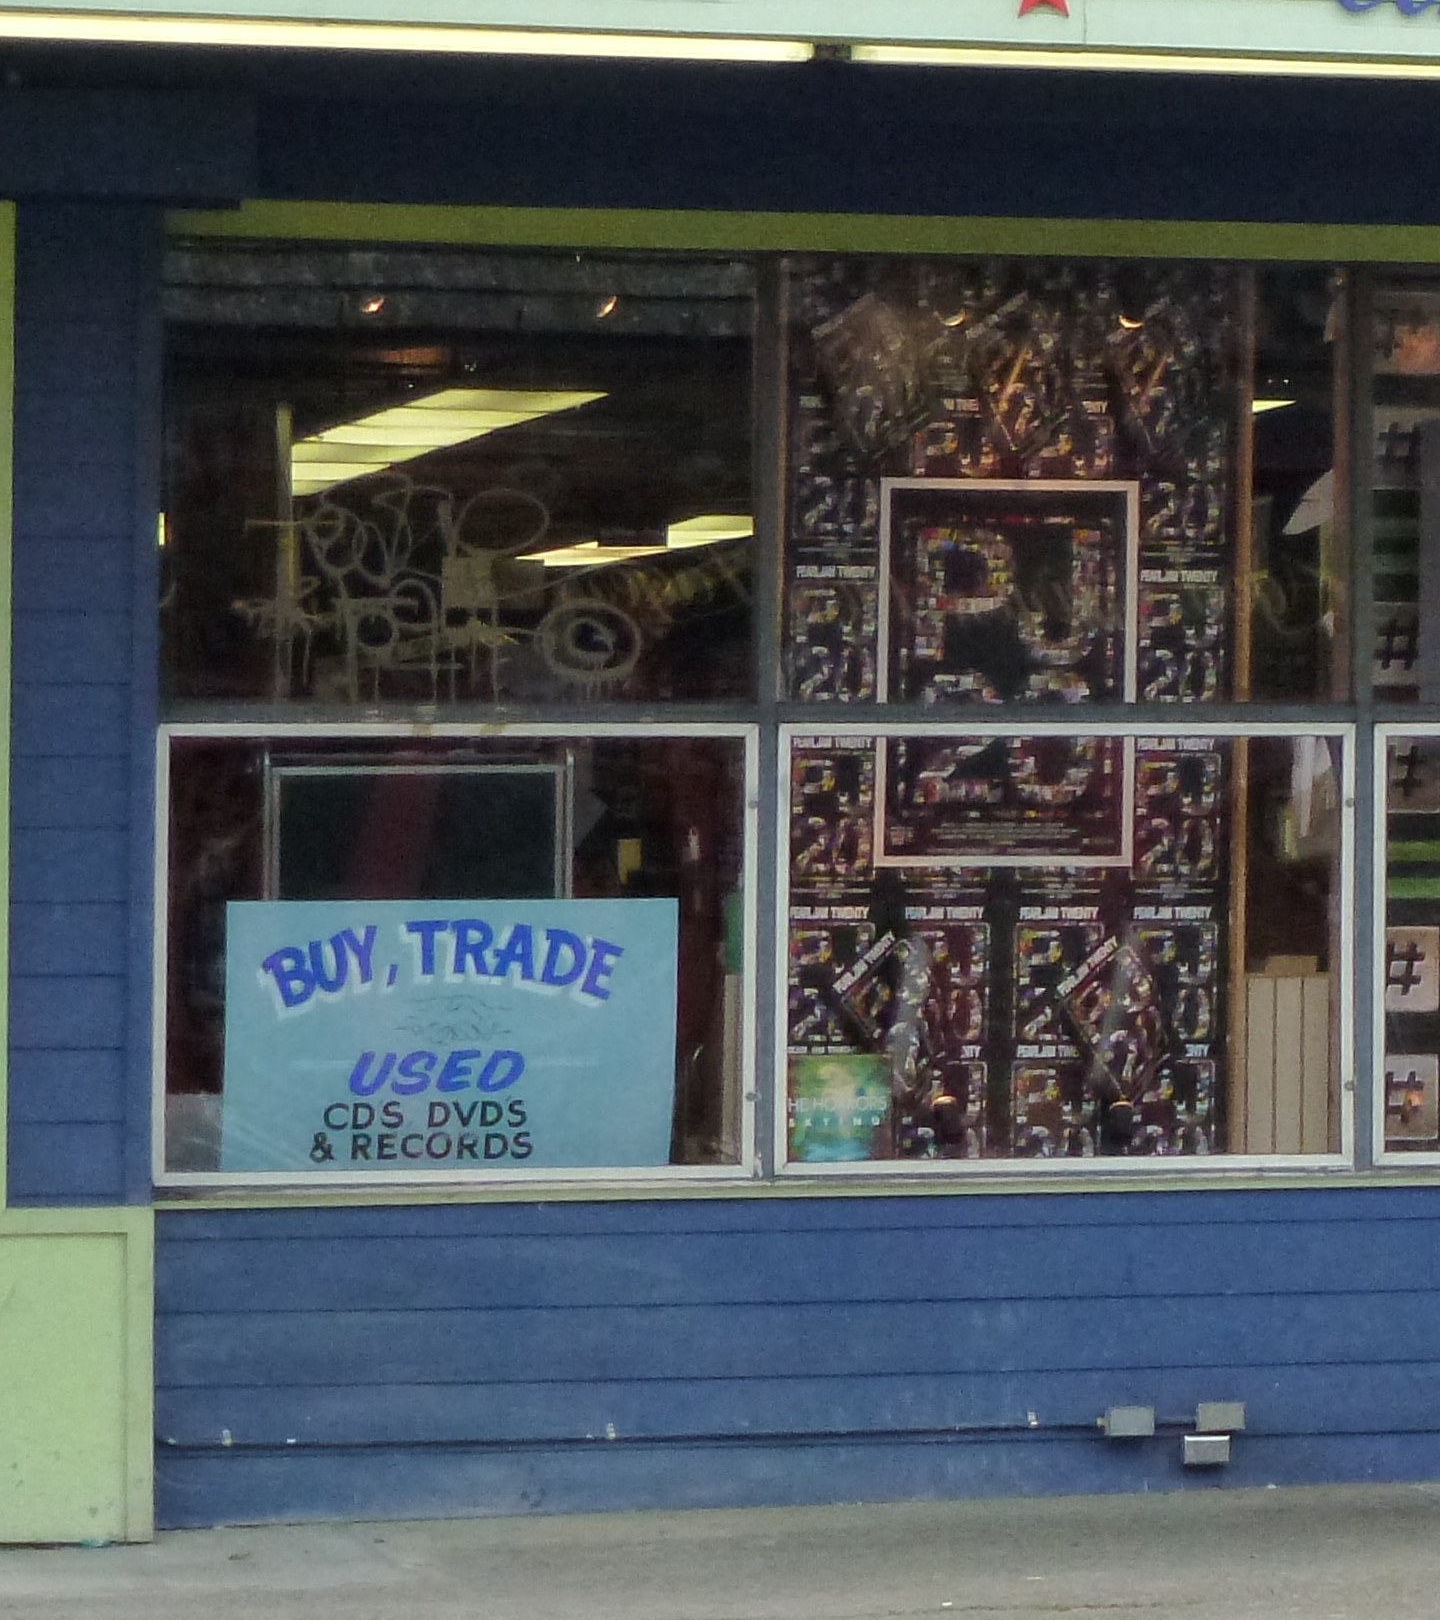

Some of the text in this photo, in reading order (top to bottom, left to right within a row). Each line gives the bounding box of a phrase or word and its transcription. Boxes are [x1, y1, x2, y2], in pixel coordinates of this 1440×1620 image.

[260, 917, 626, 1011] BUY, TRADE
[348, 1049, 526, 1097] USED
[309, 1131, 534, 1163] & RECORDS
